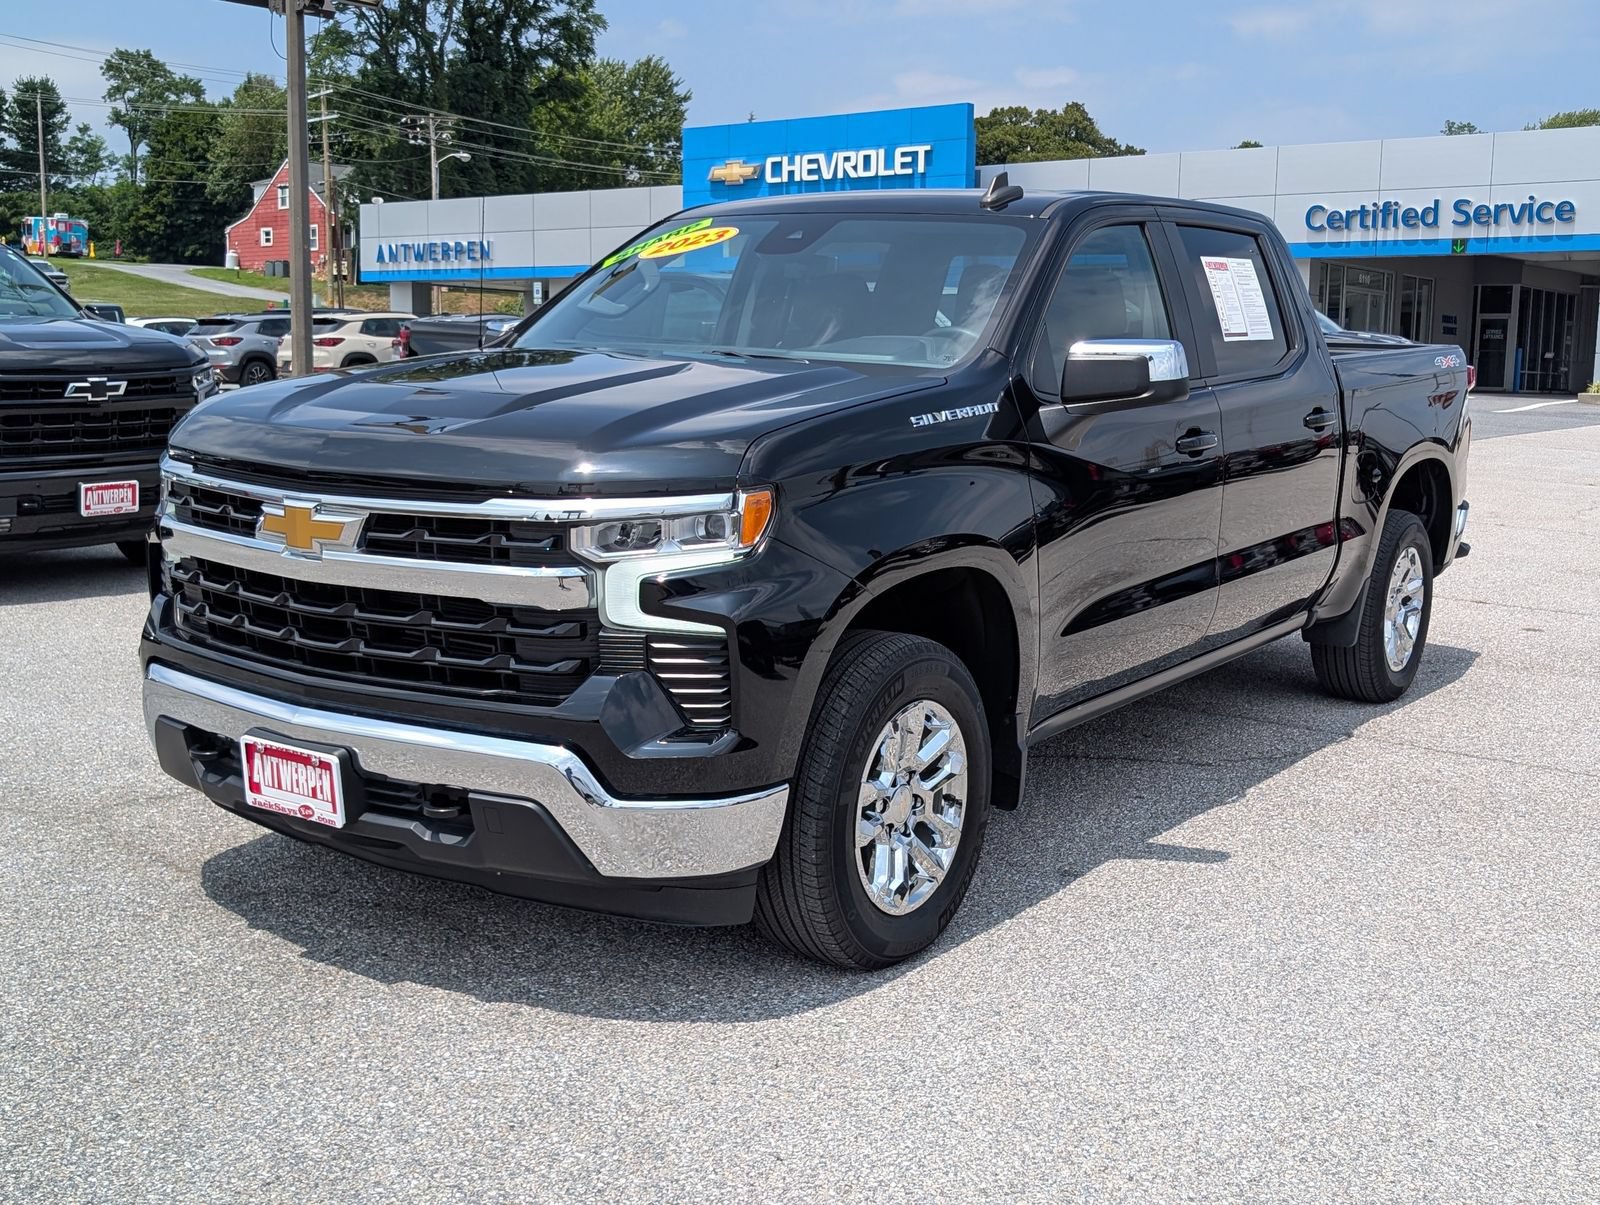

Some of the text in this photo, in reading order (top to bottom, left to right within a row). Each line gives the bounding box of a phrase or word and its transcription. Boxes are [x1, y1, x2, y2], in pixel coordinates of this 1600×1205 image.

[765, 144, 931, 184] CHEVROLET
[1304, 195, 1576, 232] Certified Service
[376, 240, 491, 263] ANTWERPEN
[613, 221, 702, 260] SHARP
[646, 229, 719, 256] 2023
[909, 402, 999, 428] SILVERADO
[86, 487, 132, 507] ANTWERPEN
[856, 676, 904, 757] MICHELIN
[253, 752, 332, 803] ANTWERPEN
